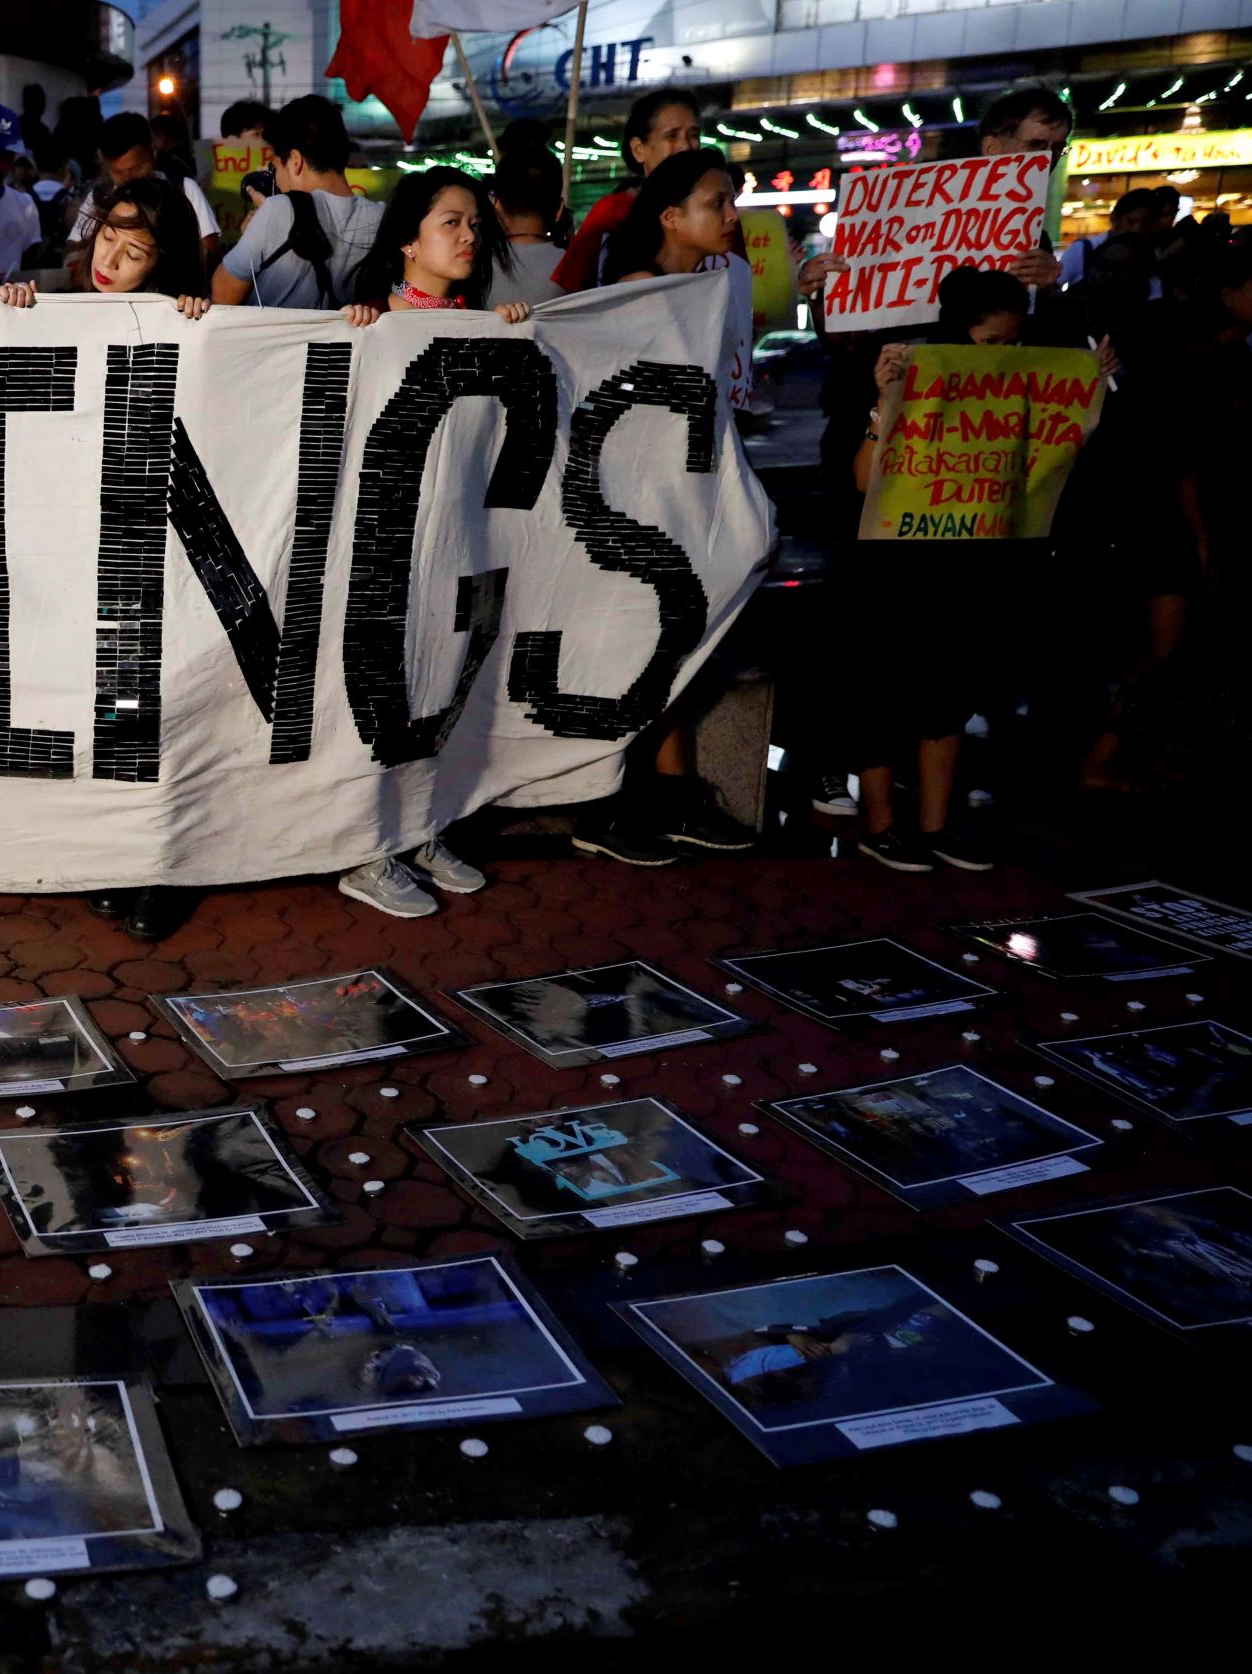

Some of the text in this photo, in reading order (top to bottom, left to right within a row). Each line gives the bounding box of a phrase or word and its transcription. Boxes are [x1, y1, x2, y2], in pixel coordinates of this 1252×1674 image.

[213, 143, 251, 173] End
[840, 154, 1050, 217] DUTERTE'S
[834, 215, 905, 258] WAR
[905, 221, 937, 245] on
[826, 254, 1019, 316] ANTI-P
[1129, 899, 1209, 918] STOP
[505, 1120, 629, 1154] LOVE
